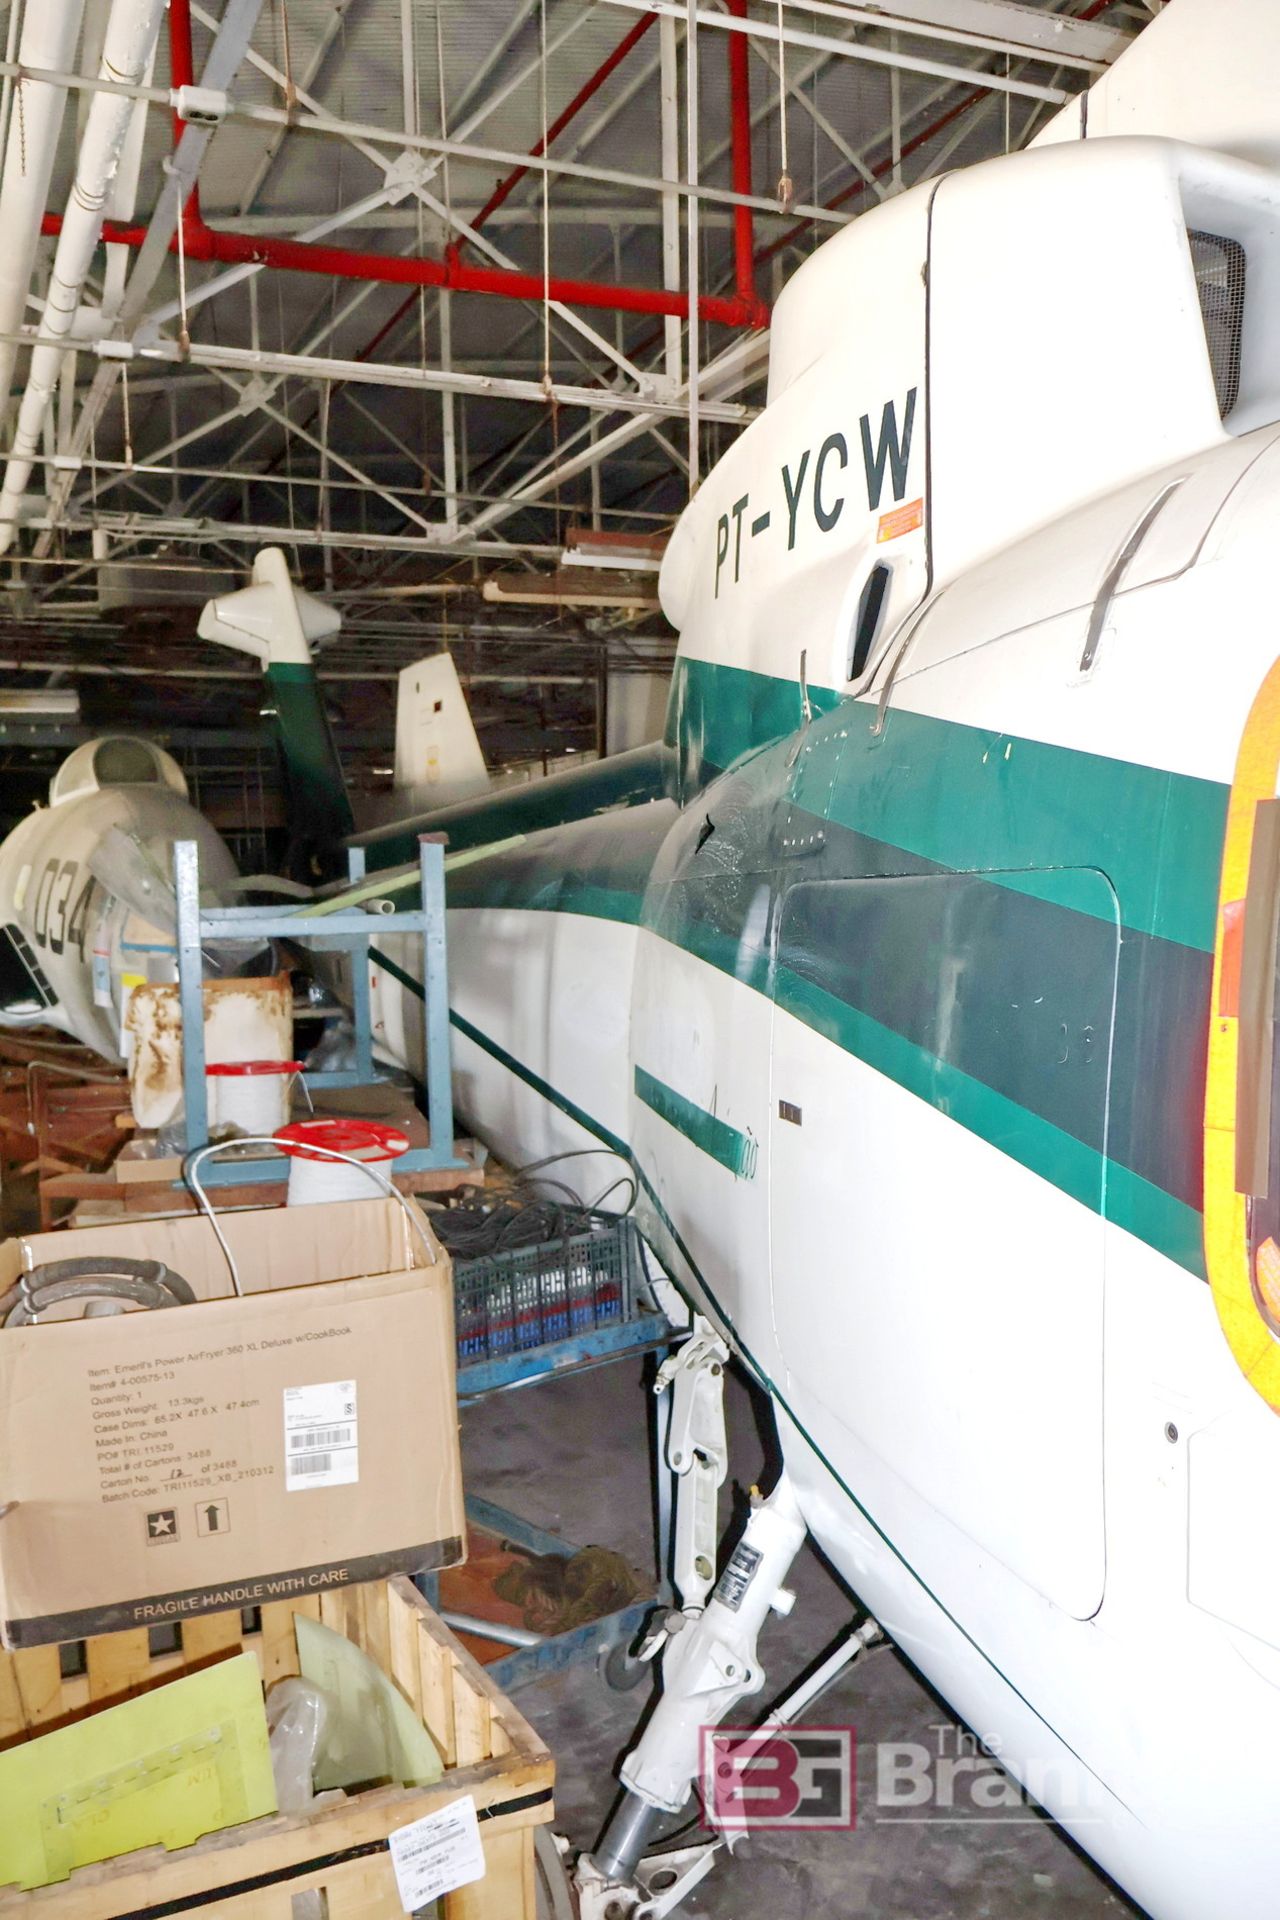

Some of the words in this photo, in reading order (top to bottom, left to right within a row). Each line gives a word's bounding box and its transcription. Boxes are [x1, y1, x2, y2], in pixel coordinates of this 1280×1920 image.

[714, 386, 918, 600] PT-YCW
[155, 1356, 184, 1367] Power
[187, 1349, 223, 1361] AirFryer
[227, 1346, 243, 1356] 360
[247, 1343, 259, 1352] XL
[261, 1337, 293, 1349] Deluxe
[296, 1327, 352, 1342] w/CookBook
[89, 1381, 116, 1392] Item#
[121, 1371, 175, 1386] 4-00575-13
[93, 1409, 121, 1420] Gross
[94, 1422, 119, 1433] Case
[96, 1436, 122, 1447] Made
[139, 1430, 168, 1441] China
[99, 1463, 121, 1475] Total
[124, 1462, 130, 1471] #
[133, 1461, 142, 1470] of
[100, 1477, 132, 1489] Carton
[201, 1464, 211, 1474] of
[102, 1493, 129, 1503] Batch
[134, 1597, 199, 1620] FRAGILE
[202, 1584, 263, 1606] HANDLE
[267, 1577, 305, 1594] WITH
[309, 1568, 349, 1586] CARE
